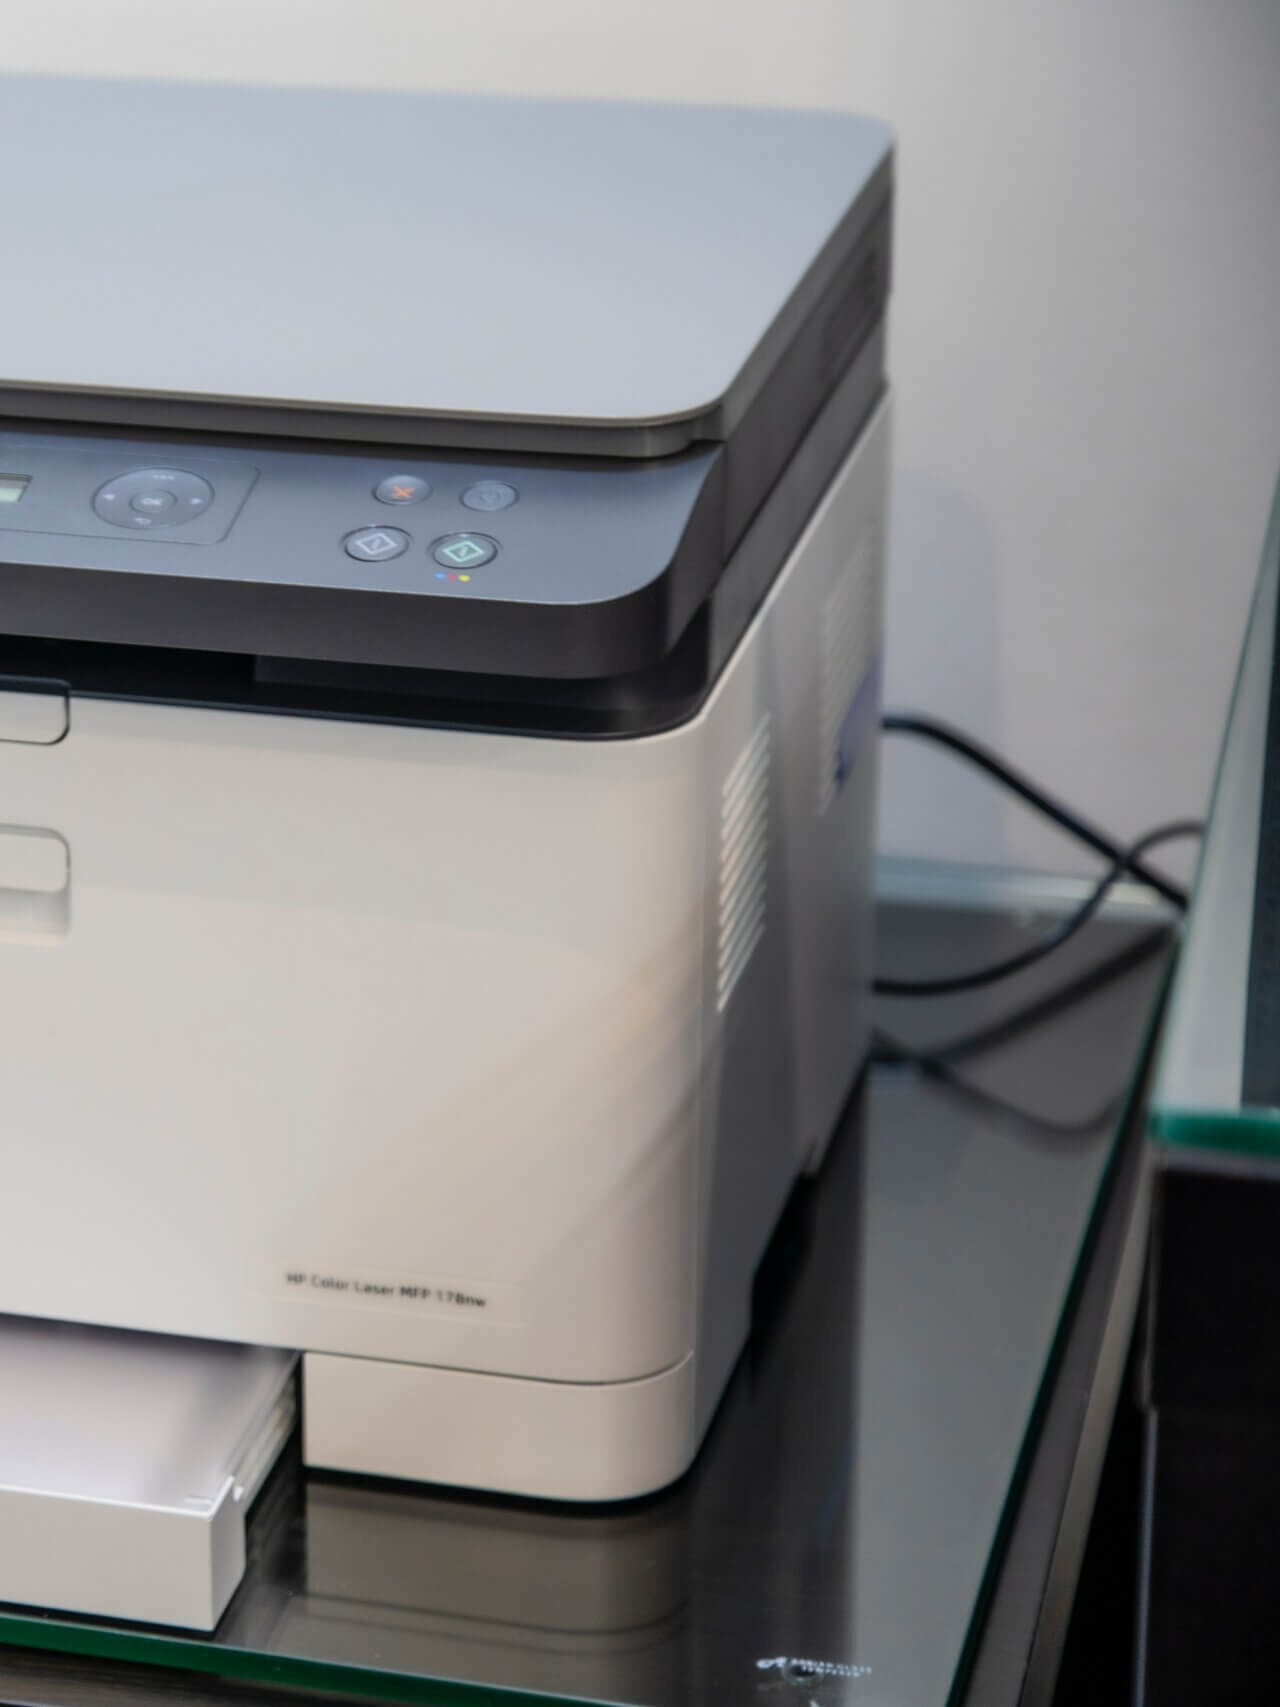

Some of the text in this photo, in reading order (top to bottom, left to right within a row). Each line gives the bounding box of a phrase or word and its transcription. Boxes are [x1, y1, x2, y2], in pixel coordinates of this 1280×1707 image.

[286, 1272, 487, 1308] HP Color Laser MFP 178nw
